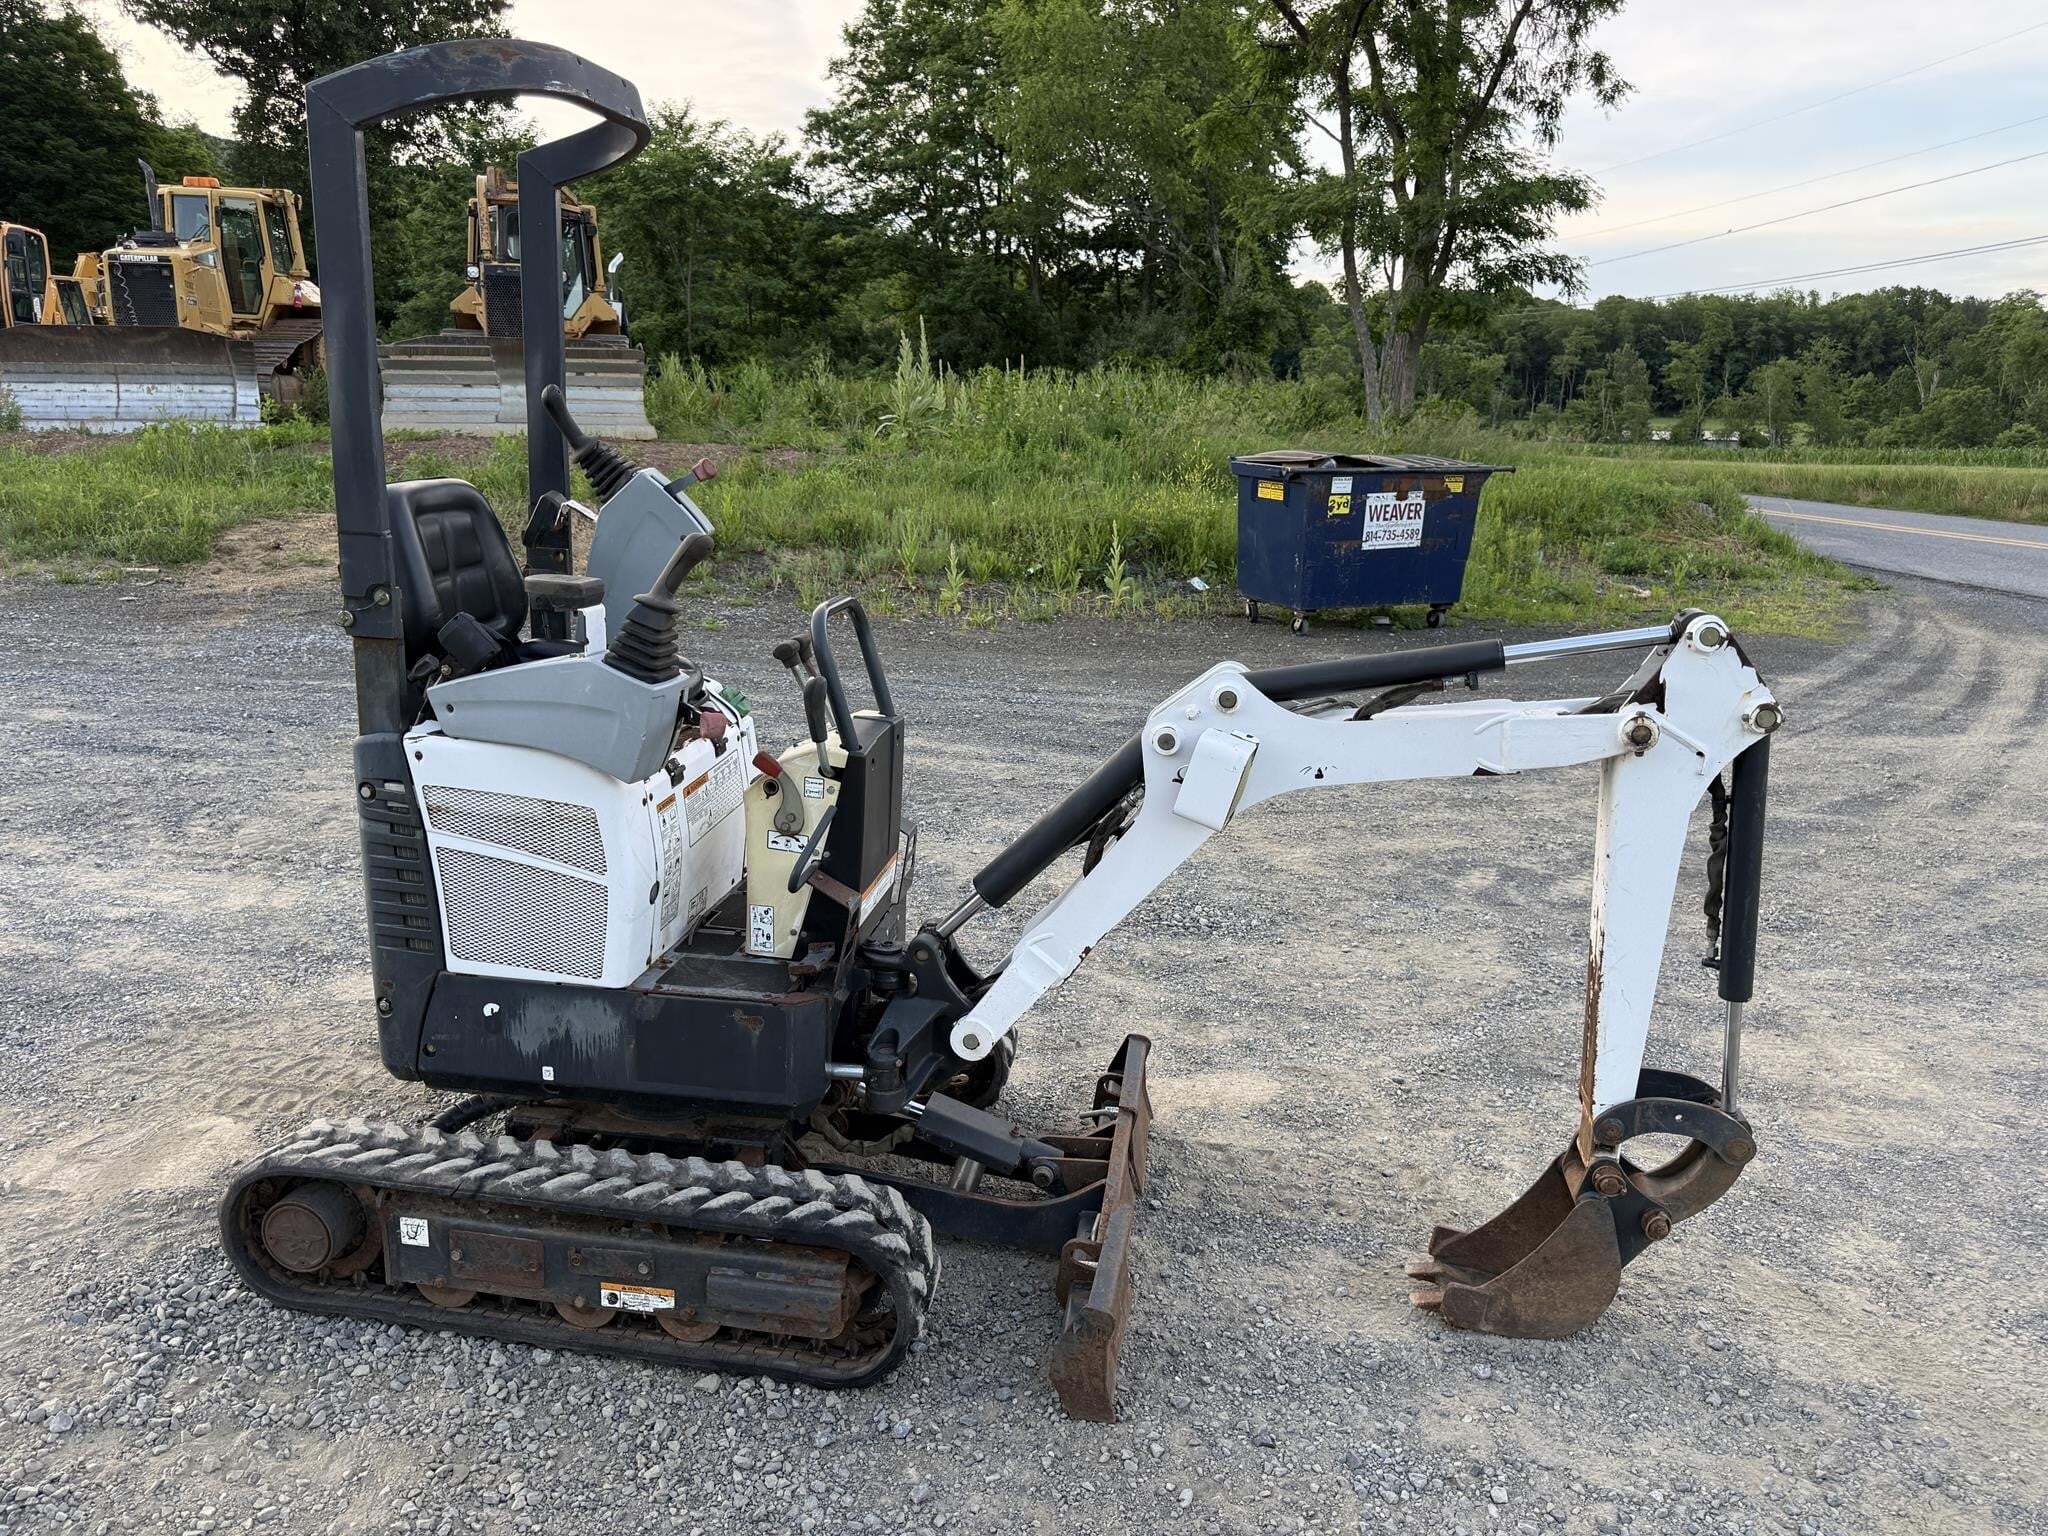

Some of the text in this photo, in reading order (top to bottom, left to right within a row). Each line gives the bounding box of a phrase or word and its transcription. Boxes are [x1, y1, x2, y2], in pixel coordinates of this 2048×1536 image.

[120, 254, 159, 262] CATERPILLAR
[1369, 502, 1422, 522] WEAVER
[1365, 529, 1420, 542] 814-735-4589
